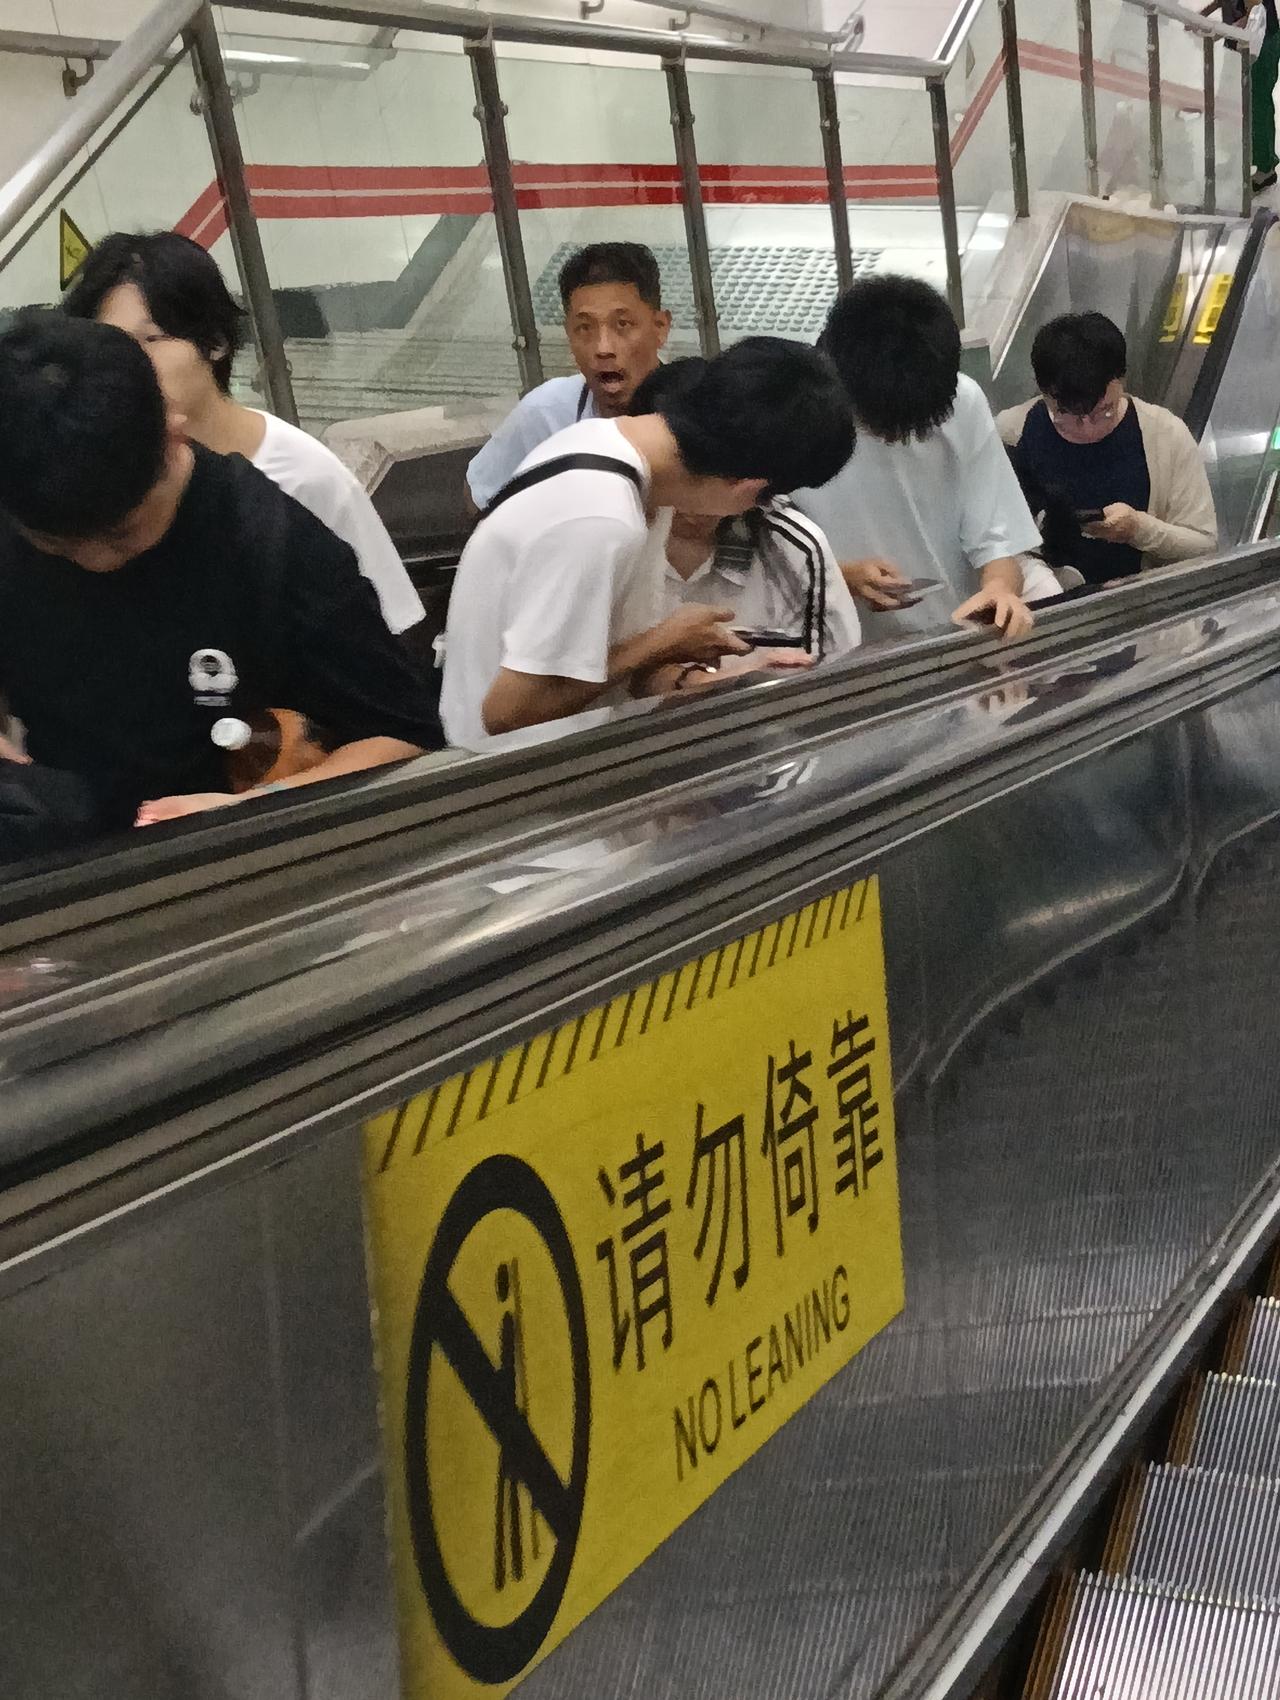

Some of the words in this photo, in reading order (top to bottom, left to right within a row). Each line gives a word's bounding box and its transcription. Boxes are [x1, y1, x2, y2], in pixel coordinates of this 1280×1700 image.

[596, 1009, 884, 1373] 请勿倚靠
[672, 1378, 722, 1482] NO
[728, 1264, 851, 1430] LEANING
